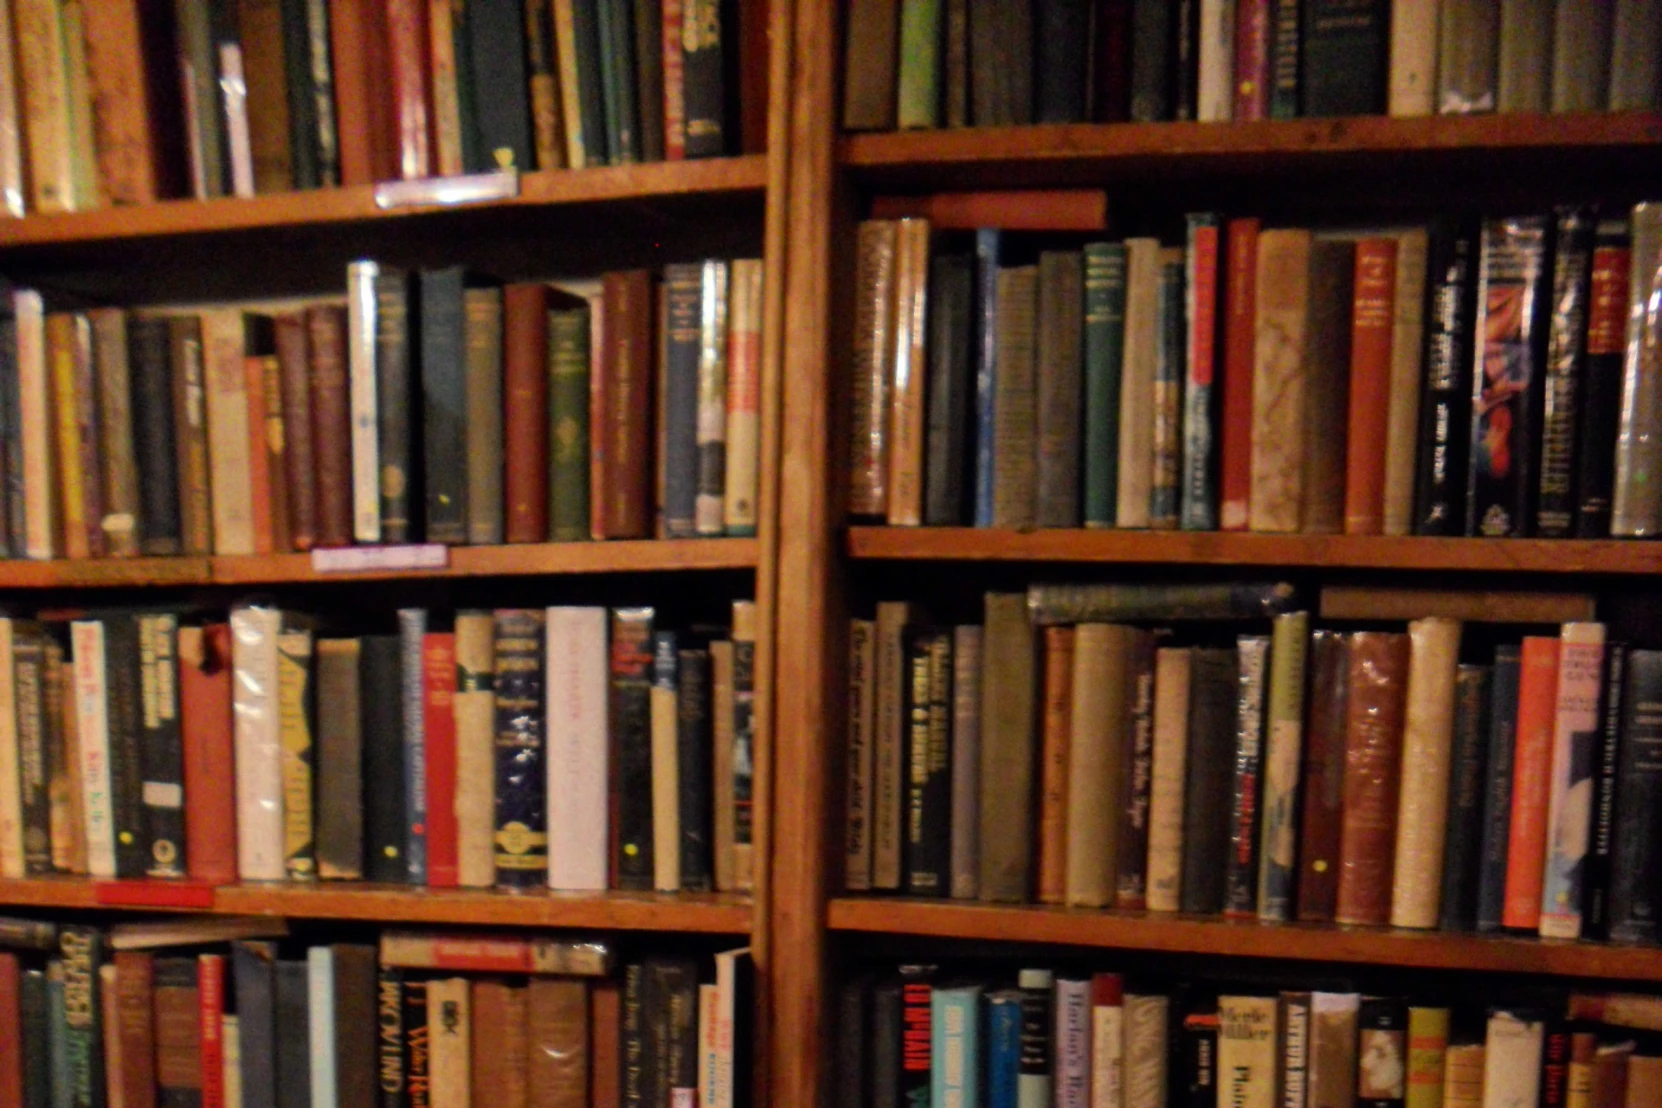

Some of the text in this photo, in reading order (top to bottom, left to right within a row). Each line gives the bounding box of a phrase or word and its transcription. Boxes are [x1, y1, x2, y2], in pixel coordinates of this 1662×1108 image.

[904, 984, 931, 1003] ED
[1066, 992, 1085, 1067] Harlan's
[1286, 1003, 1307, 1068] ARTHUR
